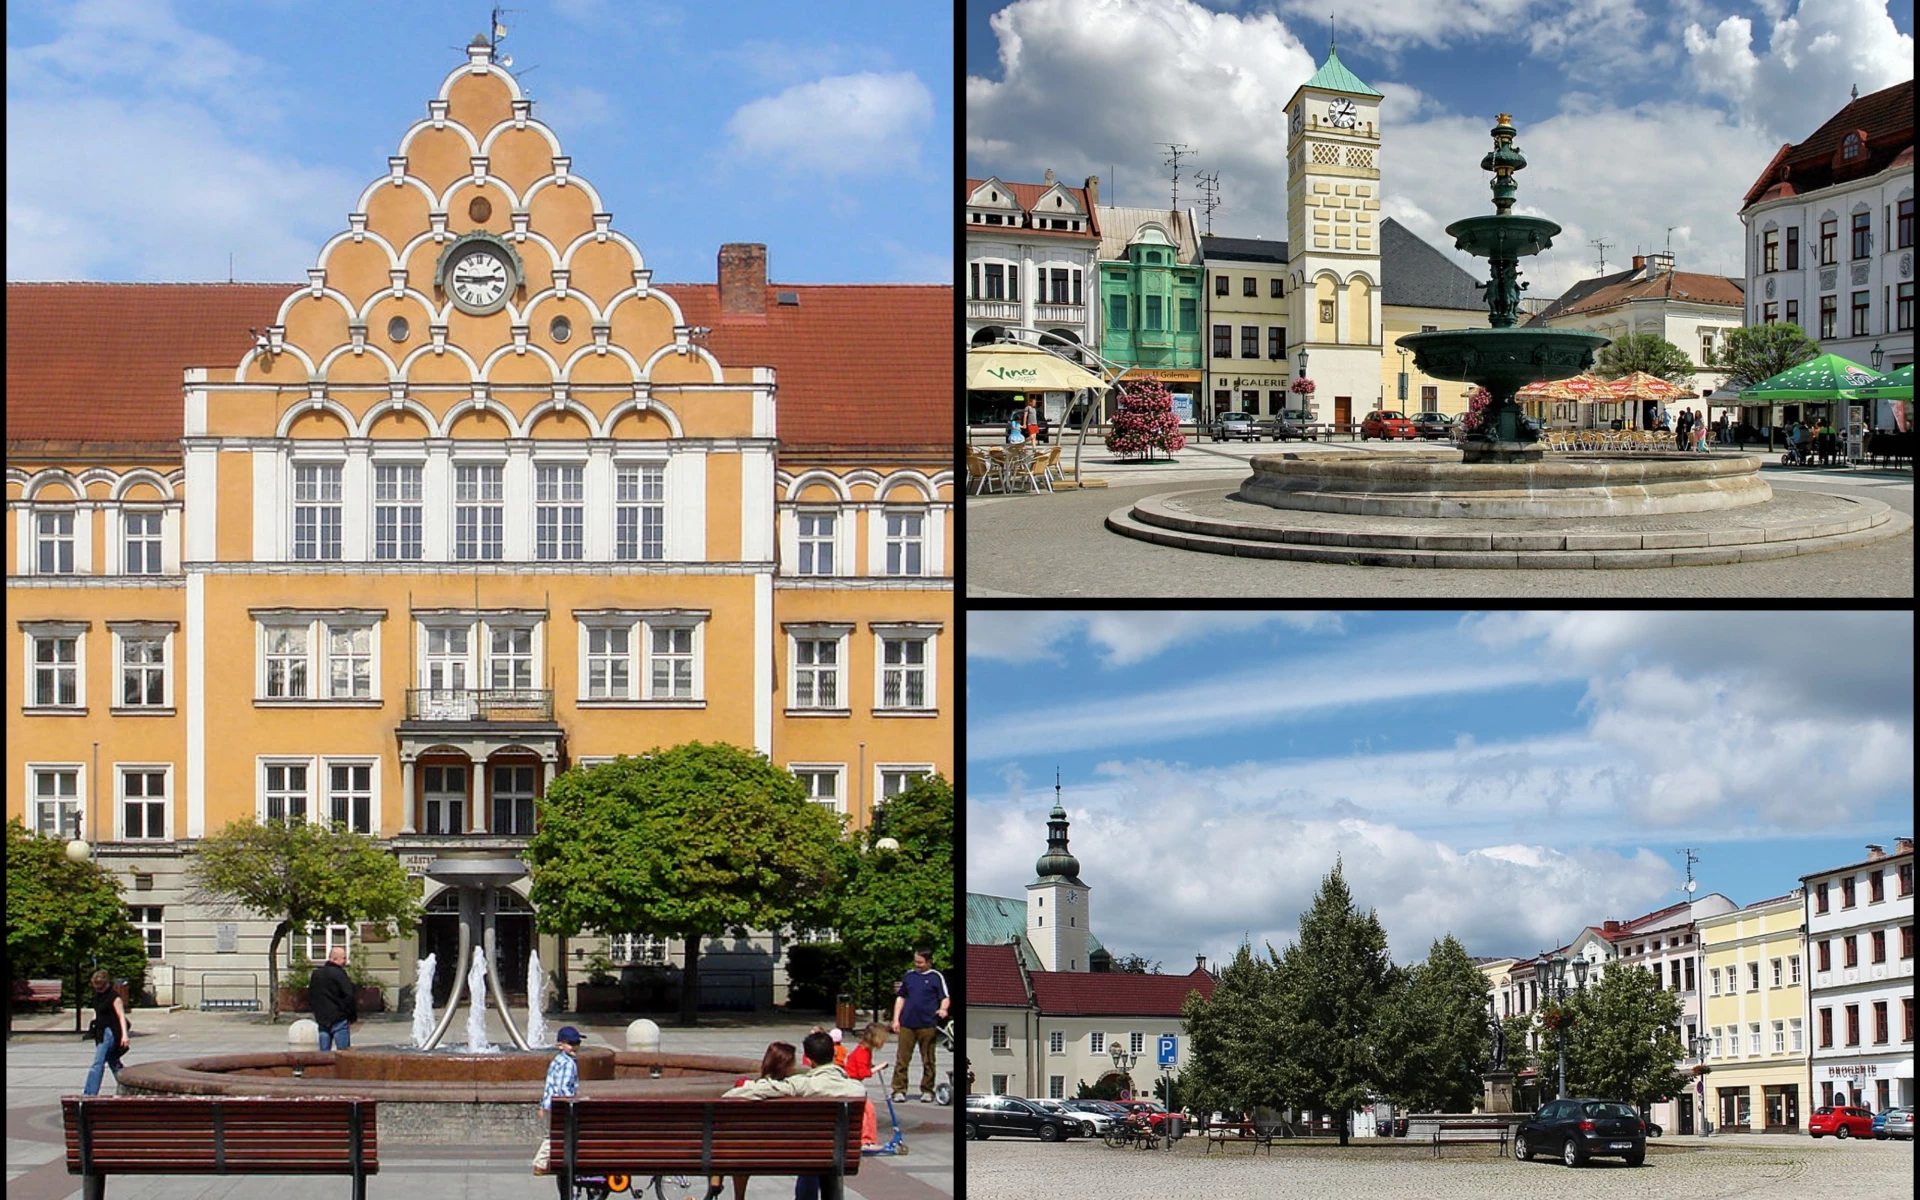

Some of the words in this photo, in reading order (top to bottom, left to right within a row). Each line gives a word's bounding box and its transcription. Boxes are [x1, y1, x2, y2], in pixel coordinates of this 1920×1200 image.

[987, 367, 1037, 379] Vinea
[1160, 371, 1189, 379] Golema
[1241, 379, 1287, 387] GALERIE
[1162, 1041, 1173, 1056] P
[1828, 1065, 1877, 1076] DROGERIE
